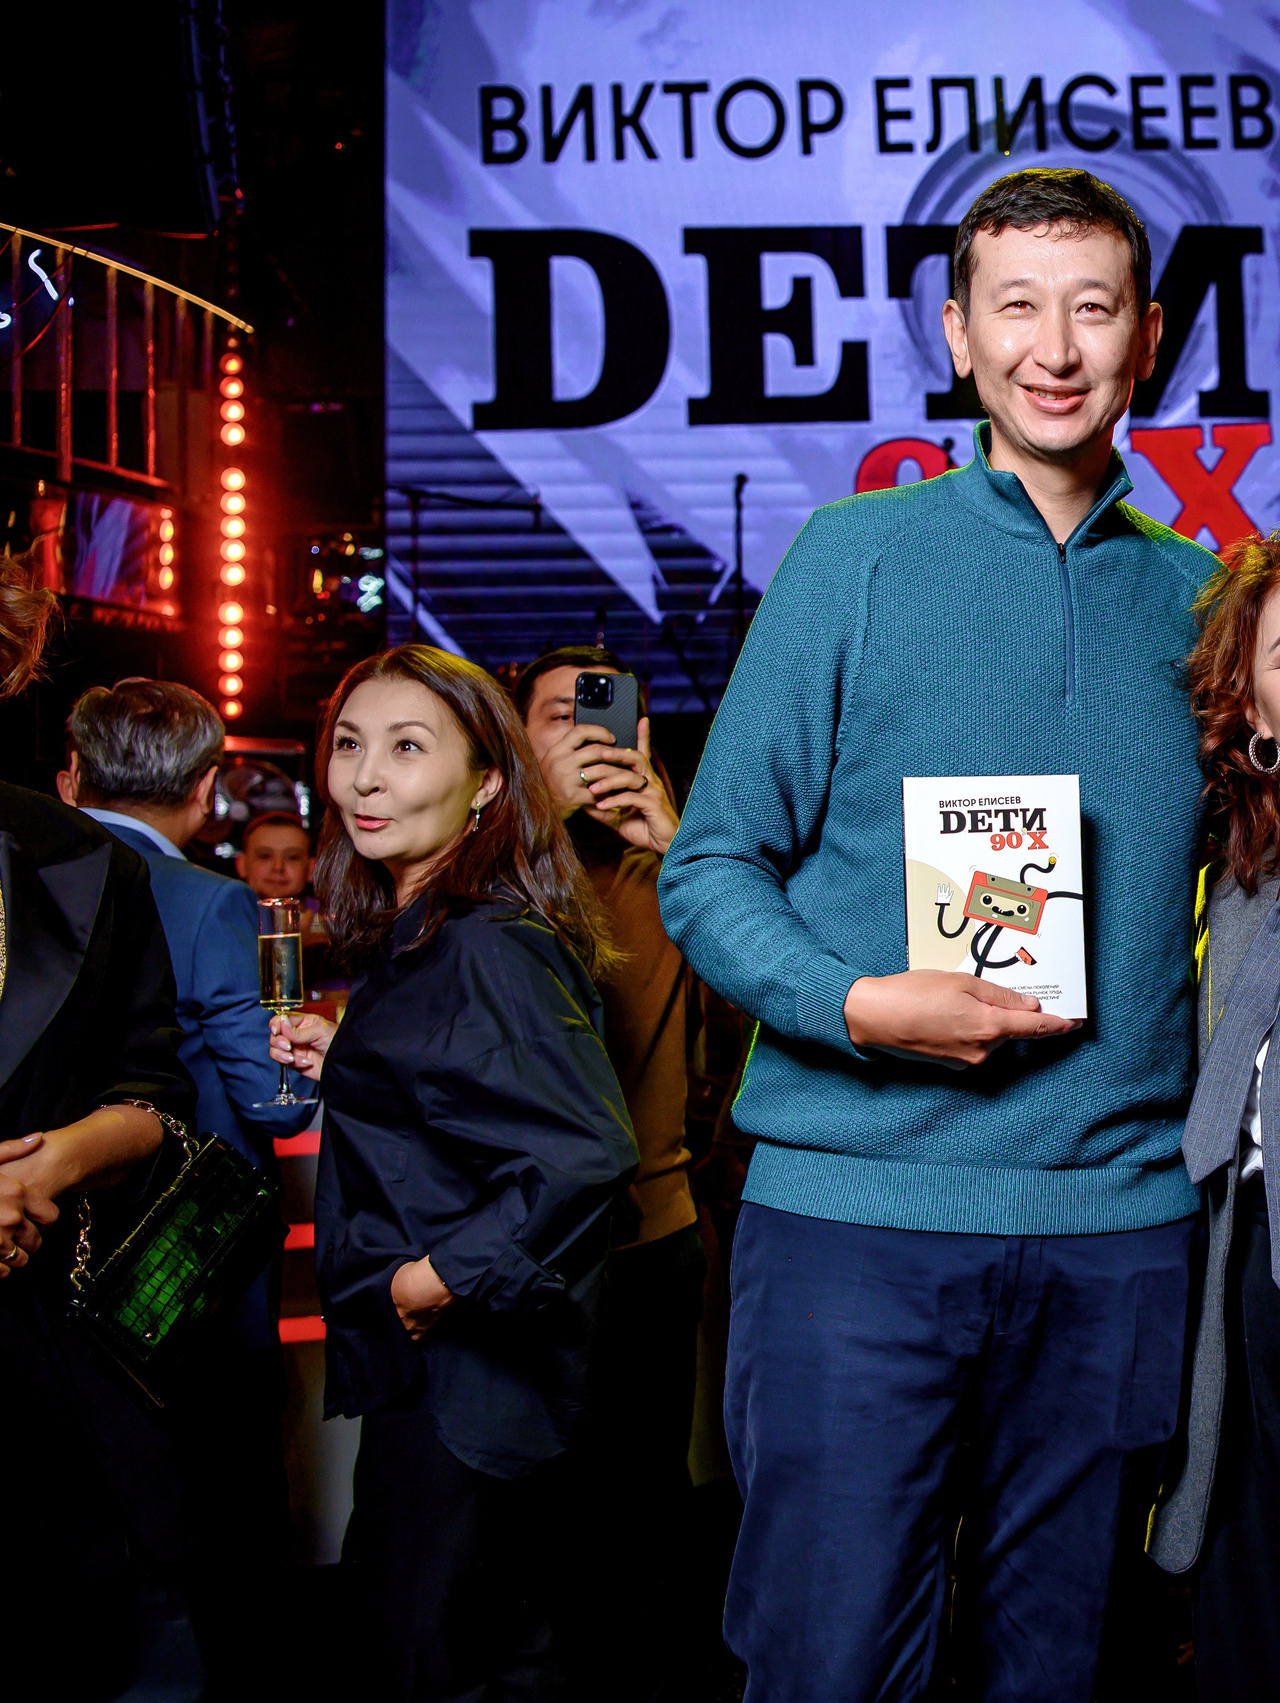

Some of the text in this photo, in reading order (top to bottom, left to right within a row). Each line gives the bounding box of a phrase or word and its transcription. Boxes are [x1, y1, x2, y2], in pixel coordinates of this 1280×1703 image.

[479, 73, 1275, 164] ВИКТОР ЕЛИСЕЕВ
[939, 796, 1021, 808] ВИКТОР ЕЛИСЕЕВ
